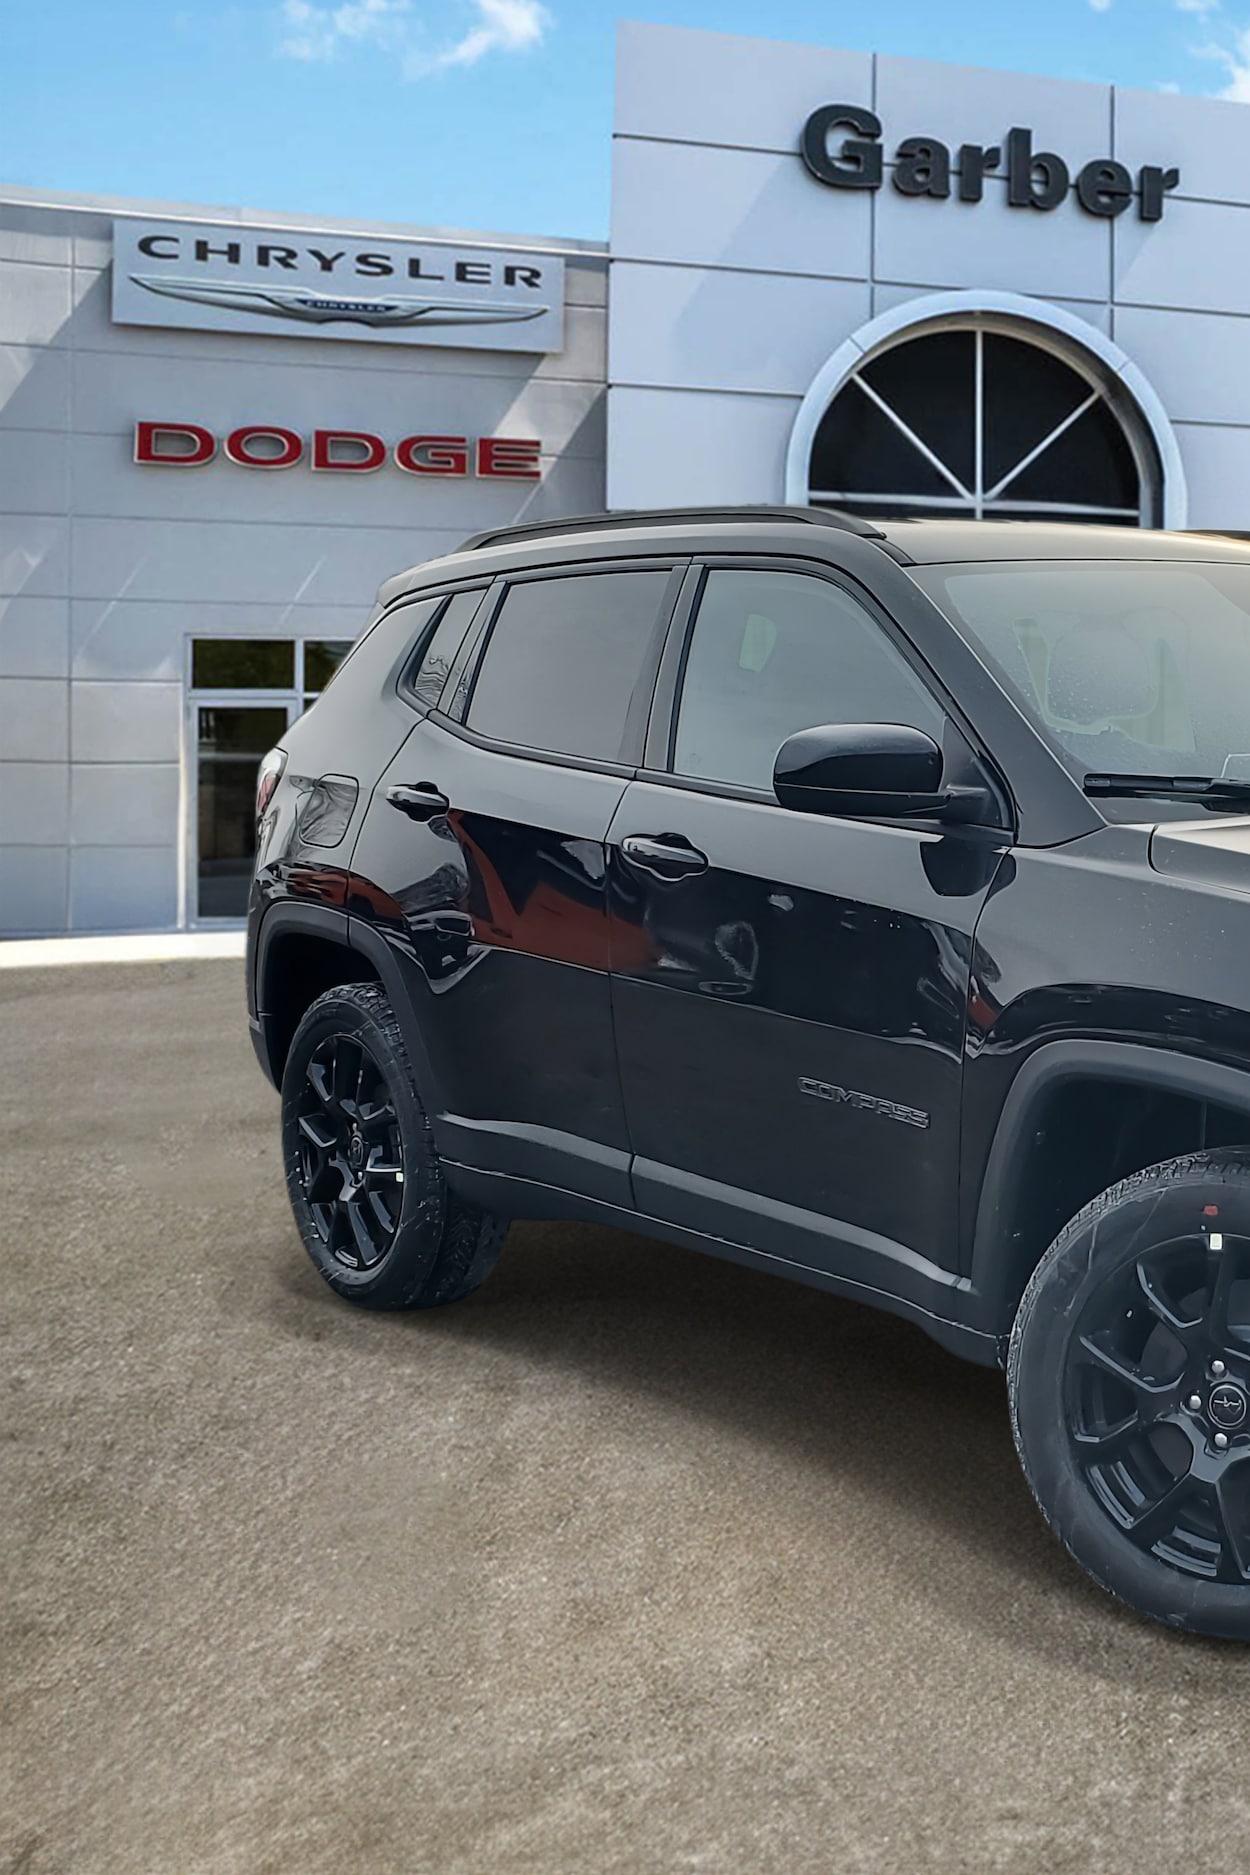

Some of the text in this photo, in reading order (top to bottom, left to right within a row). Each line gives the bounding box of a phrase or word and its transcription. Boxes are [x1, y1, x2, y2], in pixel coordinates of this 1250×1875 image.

[801, 103, 1180, 222] Garber
[137, 235, 543, 289] CHRYSLER
[134, 421, 542, 480] DODGE
[798, 1076, 930, 1128] COMPASS
